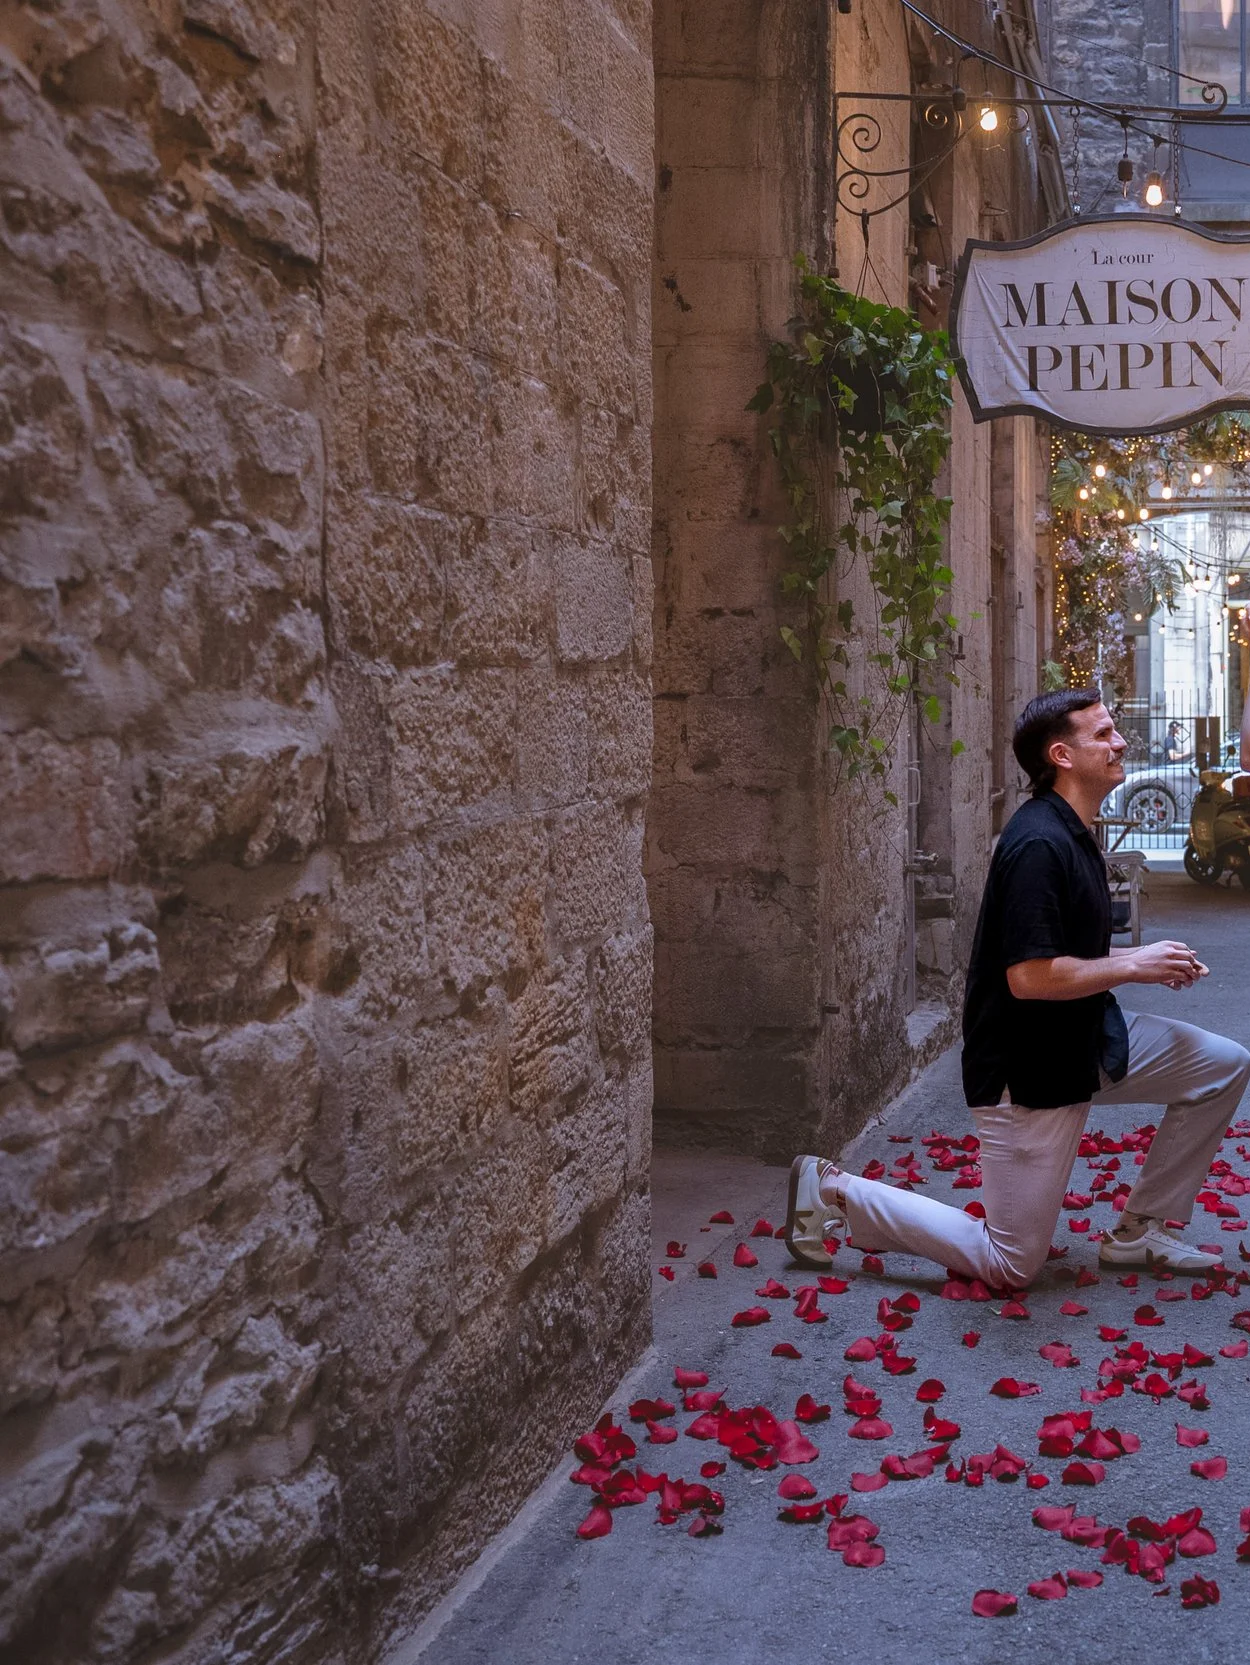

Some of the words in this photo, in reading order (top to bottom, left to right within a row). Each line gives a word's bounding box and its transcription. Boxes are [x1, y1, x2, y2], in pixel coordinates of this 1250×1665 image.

[1092, 250, 1113, 265] La
[1119, 253, 1154, 265] cour
[998, 277, 1248, 328] MAISON
[1019, 340, 1230, 392] PEPIN
